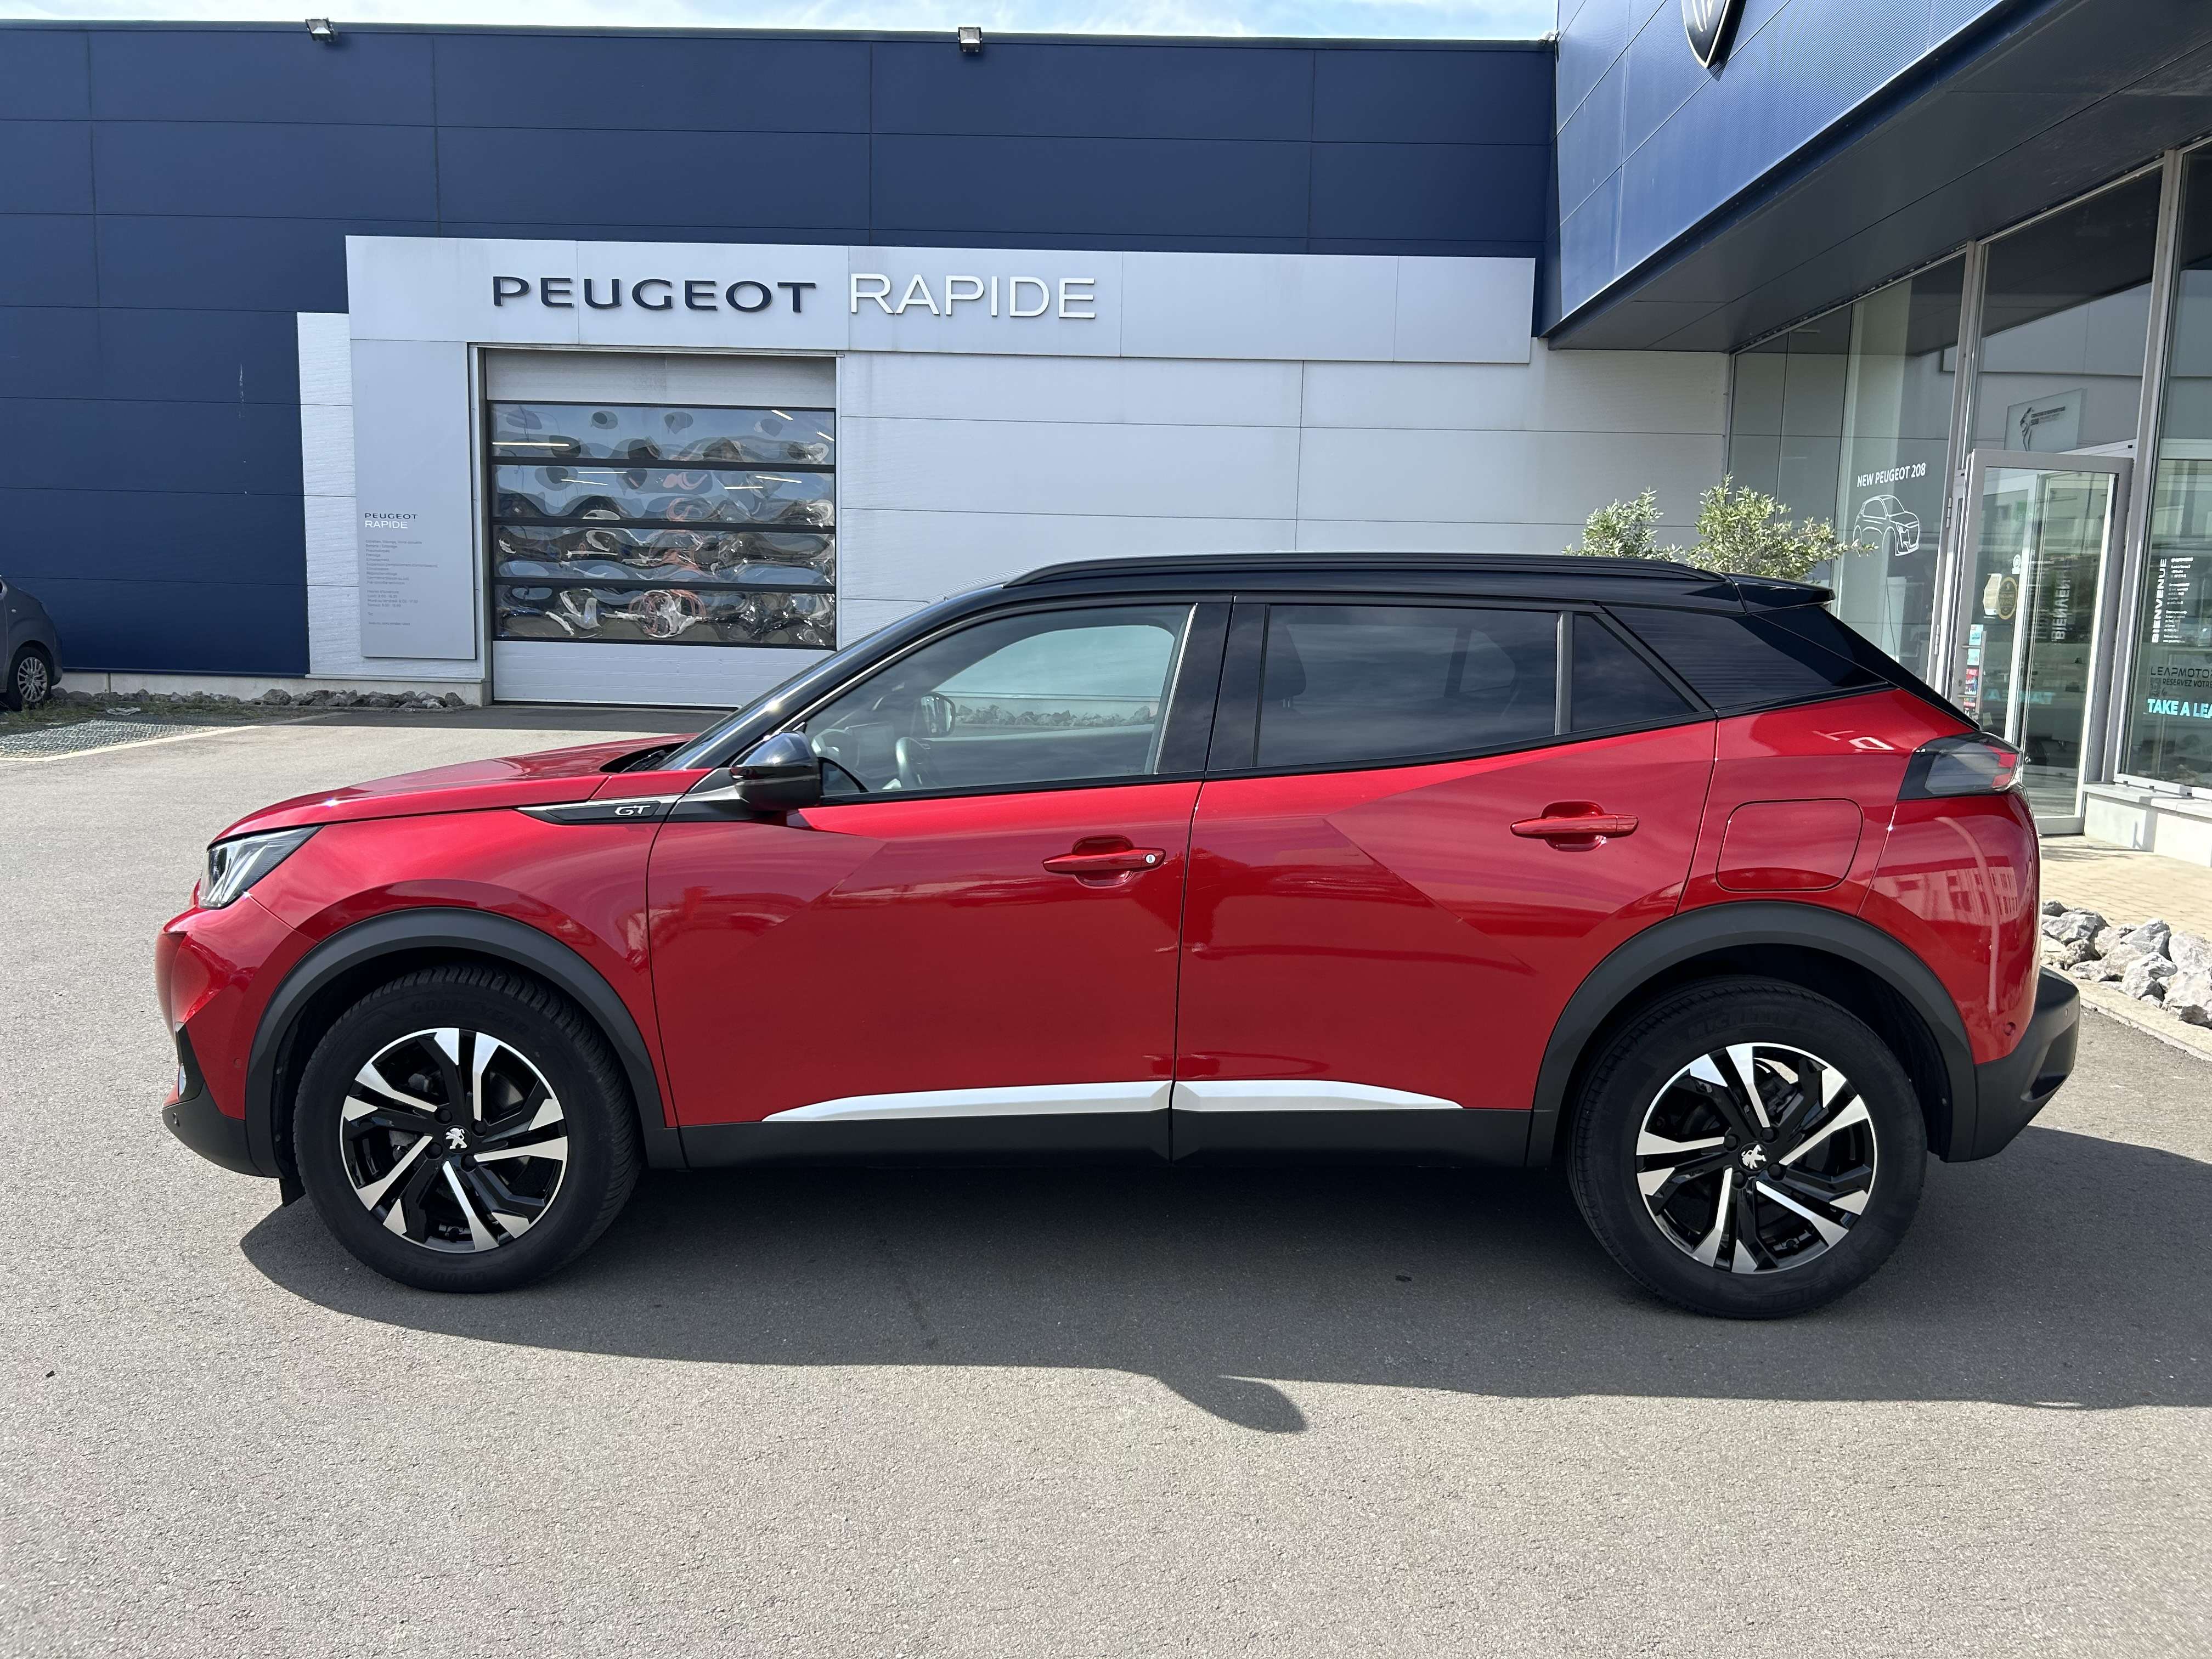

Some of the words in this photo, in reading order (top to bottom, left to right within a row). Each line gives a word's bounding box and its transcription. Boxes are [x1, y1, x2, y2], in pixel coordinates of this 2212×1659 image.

[493, 276, 816, 313] PEUGEOT
[850, 273, 1096, 318] RAPIDE
[1857, 473, 1874, 488] NEW
[1875, 465, 1910, 484] PEUGEOT
[1911, 462, 1926, 478] 208
[365, 520, 408, 529] RAPIDE
[2152, 558, 2167, 643] BIENVENUE
[2163, 678, 2192, 687] RESERVEZ
[2147, 698, 2179, 715] TAKE
[2180, 701, 2190, 716] A
[614, 805, 651, 816] GT
